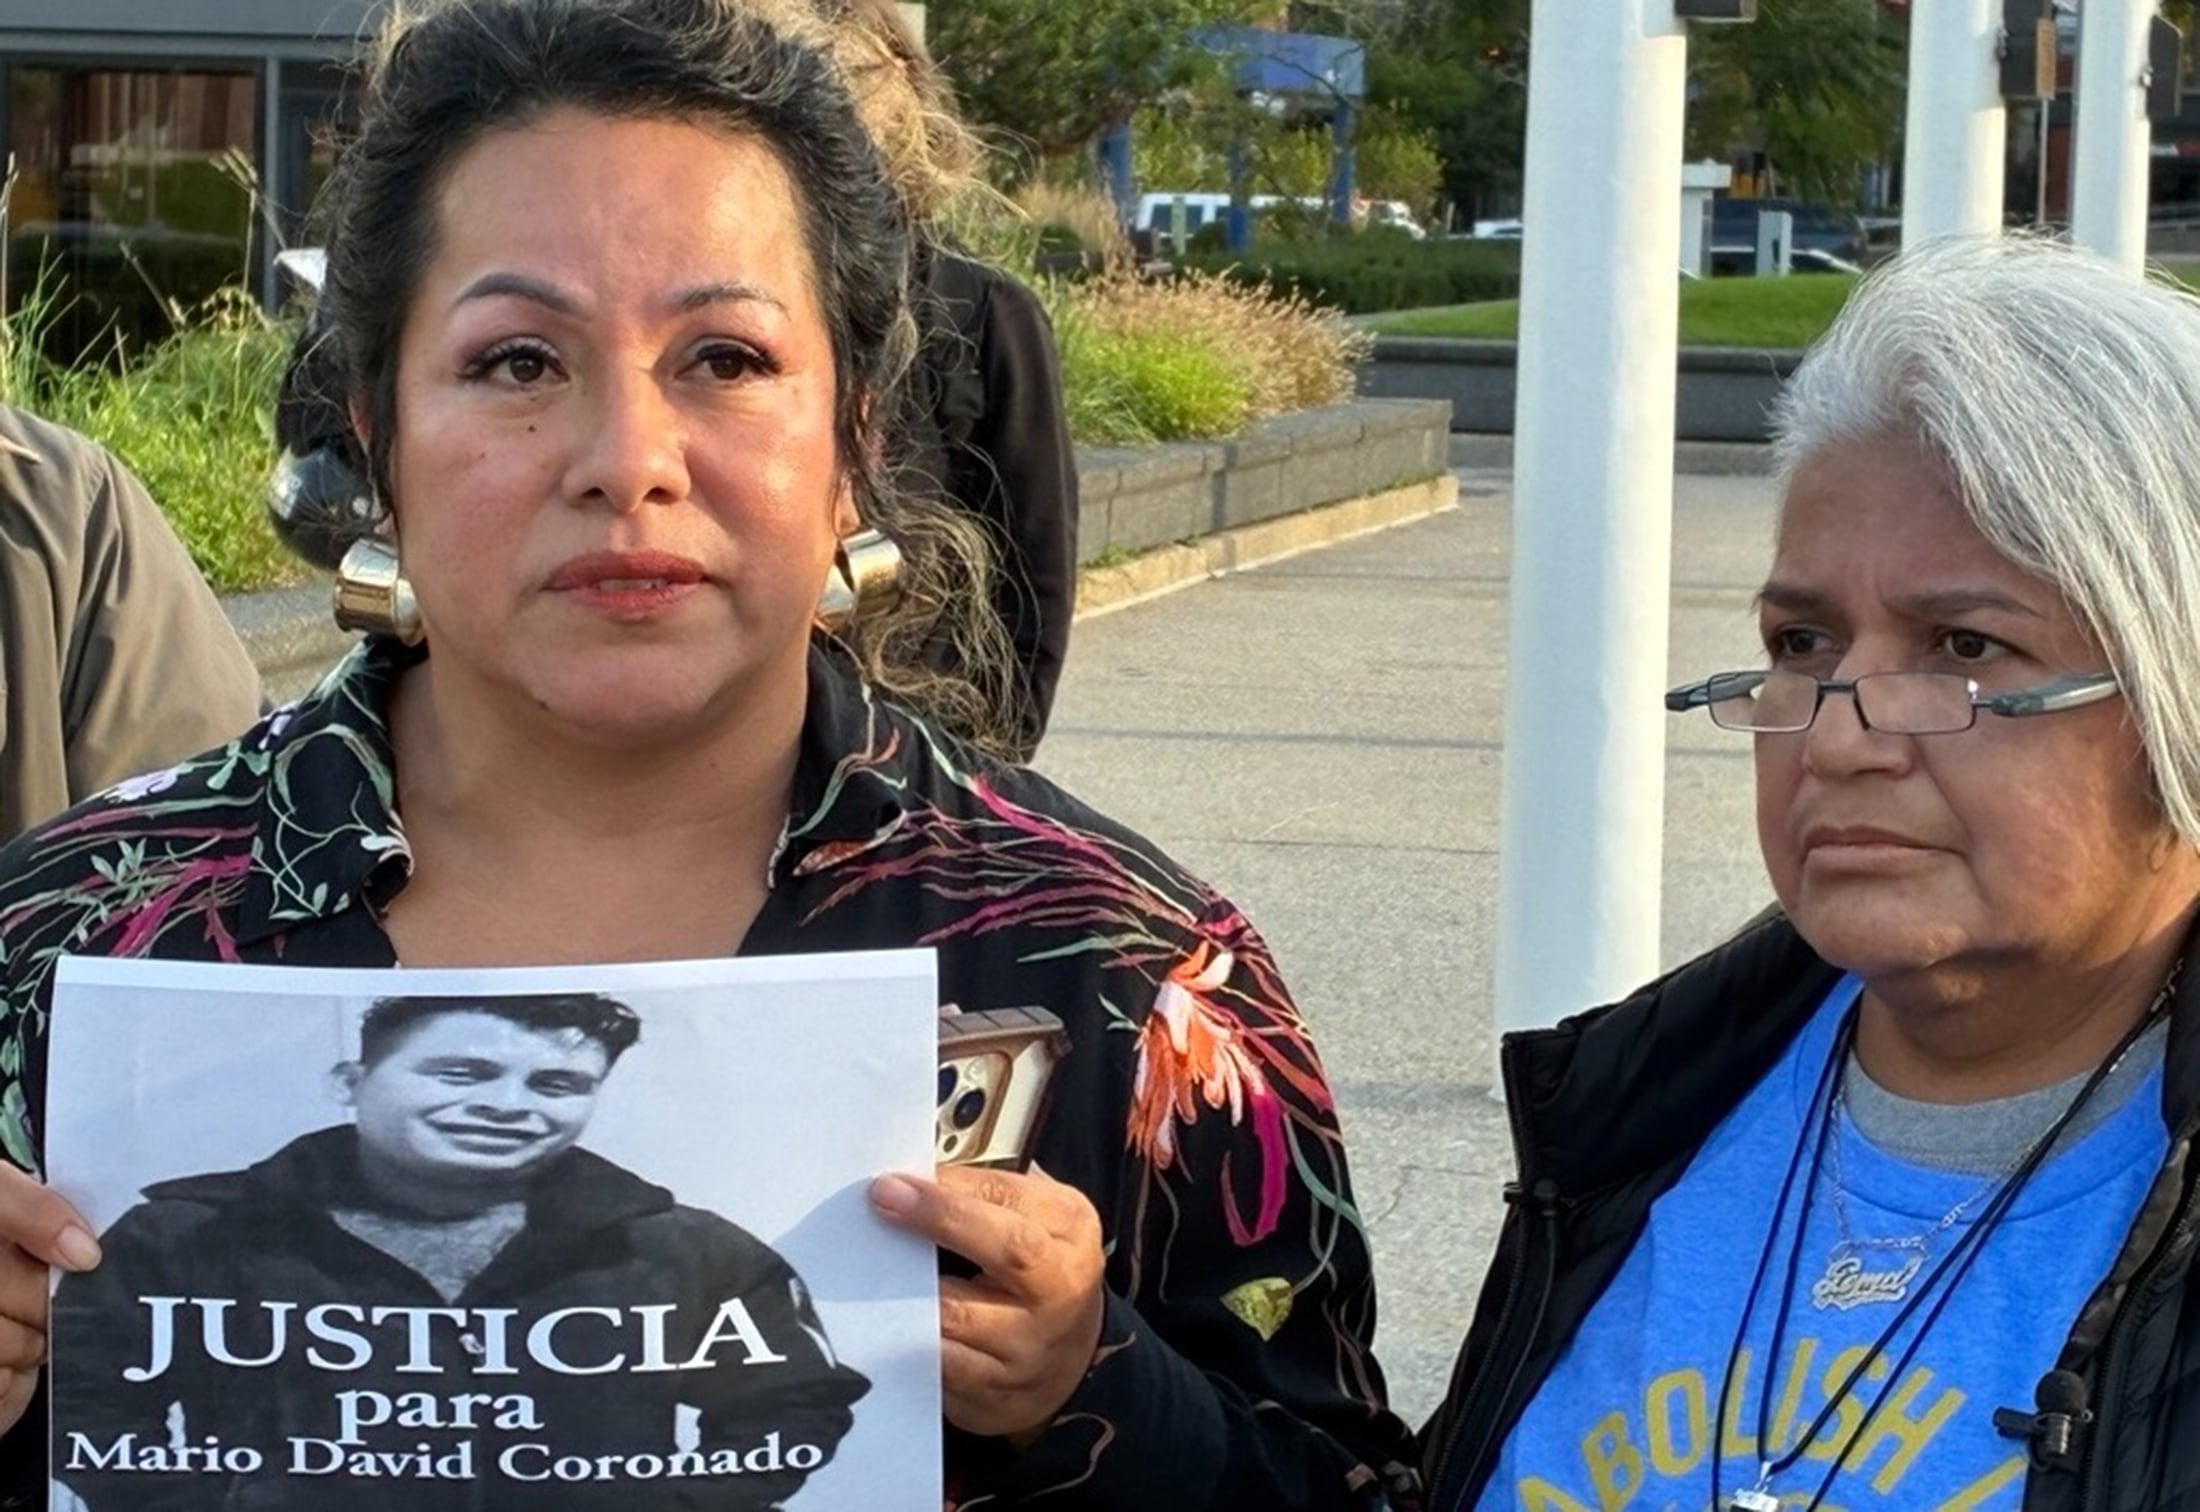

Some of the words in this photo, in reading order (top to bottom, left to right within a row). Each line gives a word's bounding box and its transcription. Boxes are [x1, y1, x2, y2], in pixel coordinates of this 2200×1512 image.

[123, 1296, 787, 1382] JUSTICIA
[335, 1390, 544, 1445] para
[66, 1432, 262, 1472] Mario
[287, 1437, 476, 1478] David
[499, 1431, 822, 1480] Coronado
